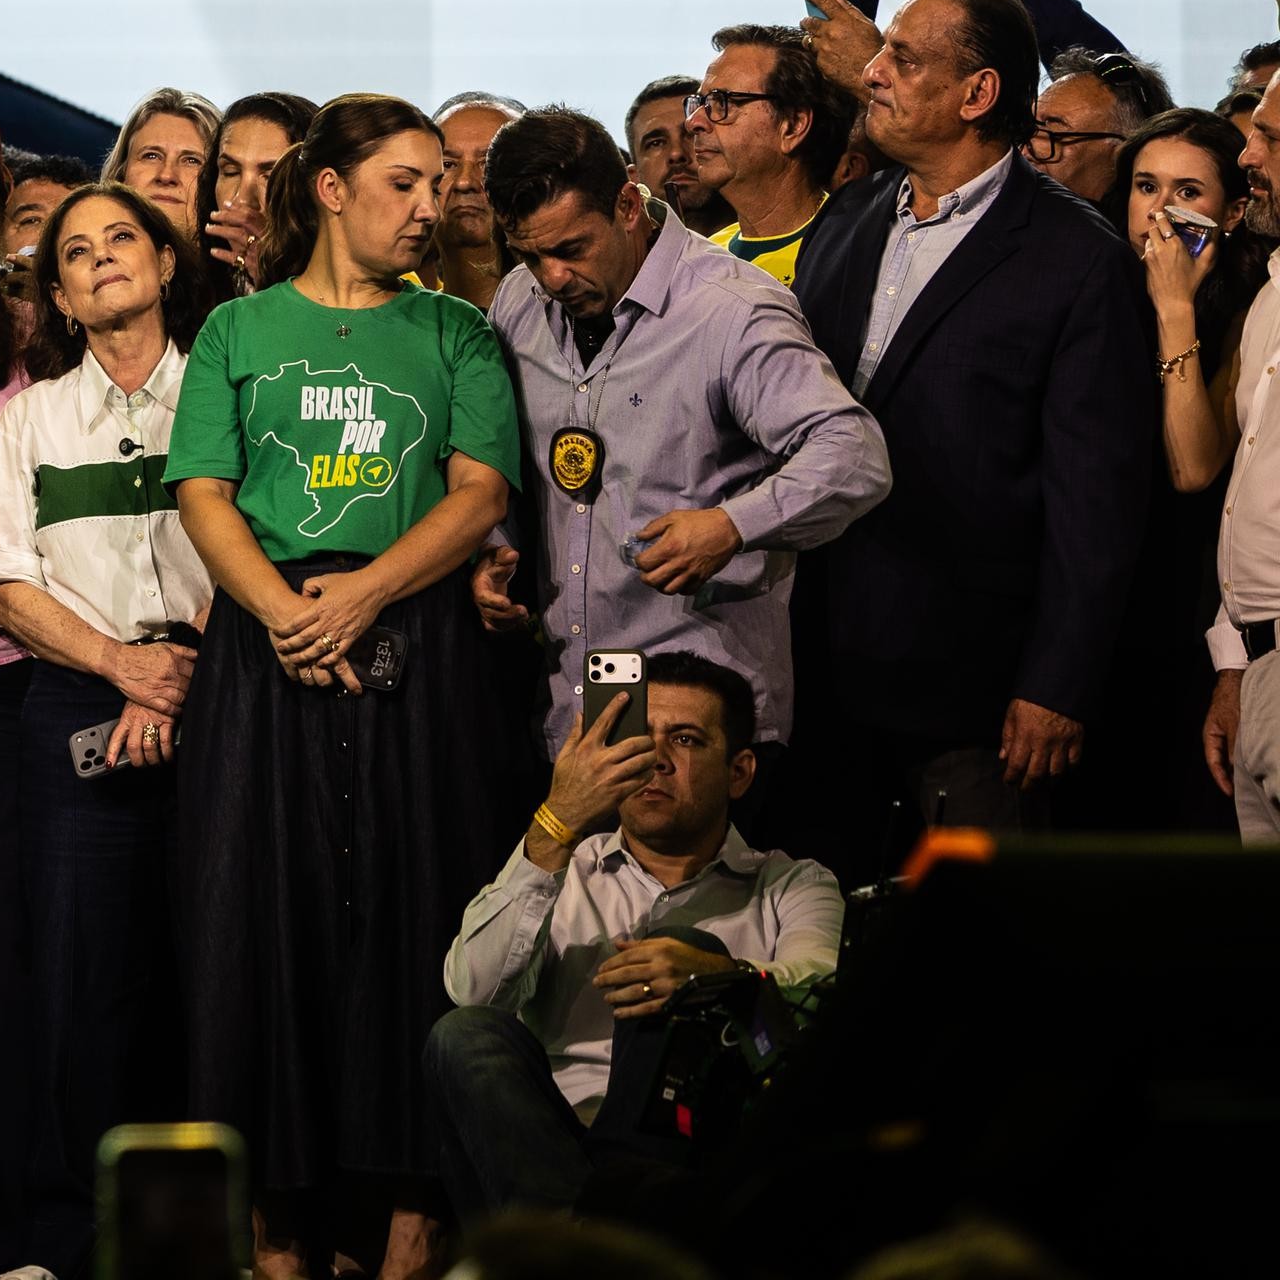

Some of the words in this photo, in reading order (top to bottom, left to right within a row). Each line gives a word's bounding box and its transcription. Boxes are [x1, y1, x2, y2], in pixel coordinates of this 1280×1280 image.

[300, 385, 376, 421] BRASIL
[338, 420, 387, 454] POR
[309, 454, 361, 489] ELAS
[370, 640, 390, 677] 13:43
